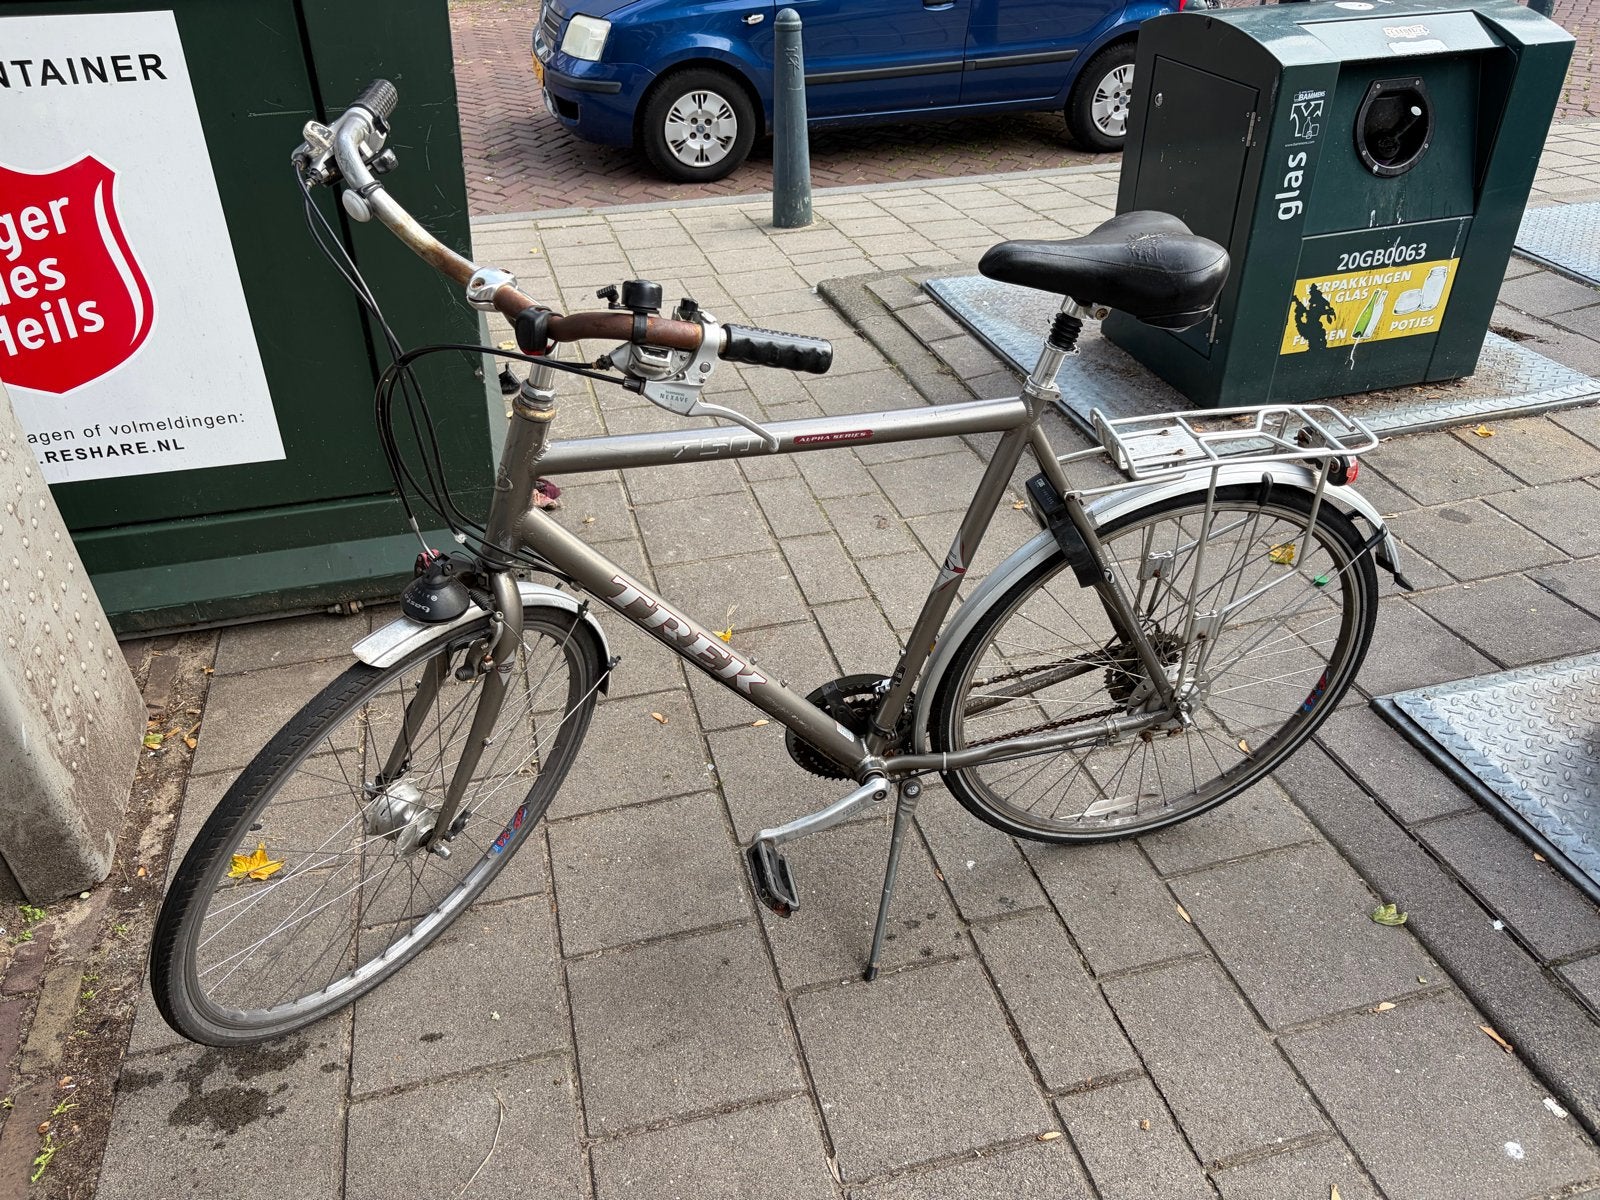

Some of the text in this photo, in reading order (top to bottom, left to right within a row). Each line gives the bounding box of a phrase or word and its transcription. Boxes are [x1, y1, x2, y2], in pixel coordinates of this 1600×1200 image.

[1275, 151, 1307, 221] glas
[1337, 243, 1427, 271] 20GB0063
[1303, 288, 1369, 309] VN GLAS
[1389, 315, 1434, 332] POTJES
[1292, 328, 1348, 347] FLEN
[659, 393, 688, 403] NEXAVE
[83, 424, 101, 438] of
[109, 413, 244, 434] volmeldingen:
[799, 435, 830, 443] ALPHA
[832, 432, 866, 440] SERIES
[606, 574, 767, 694] TREK
